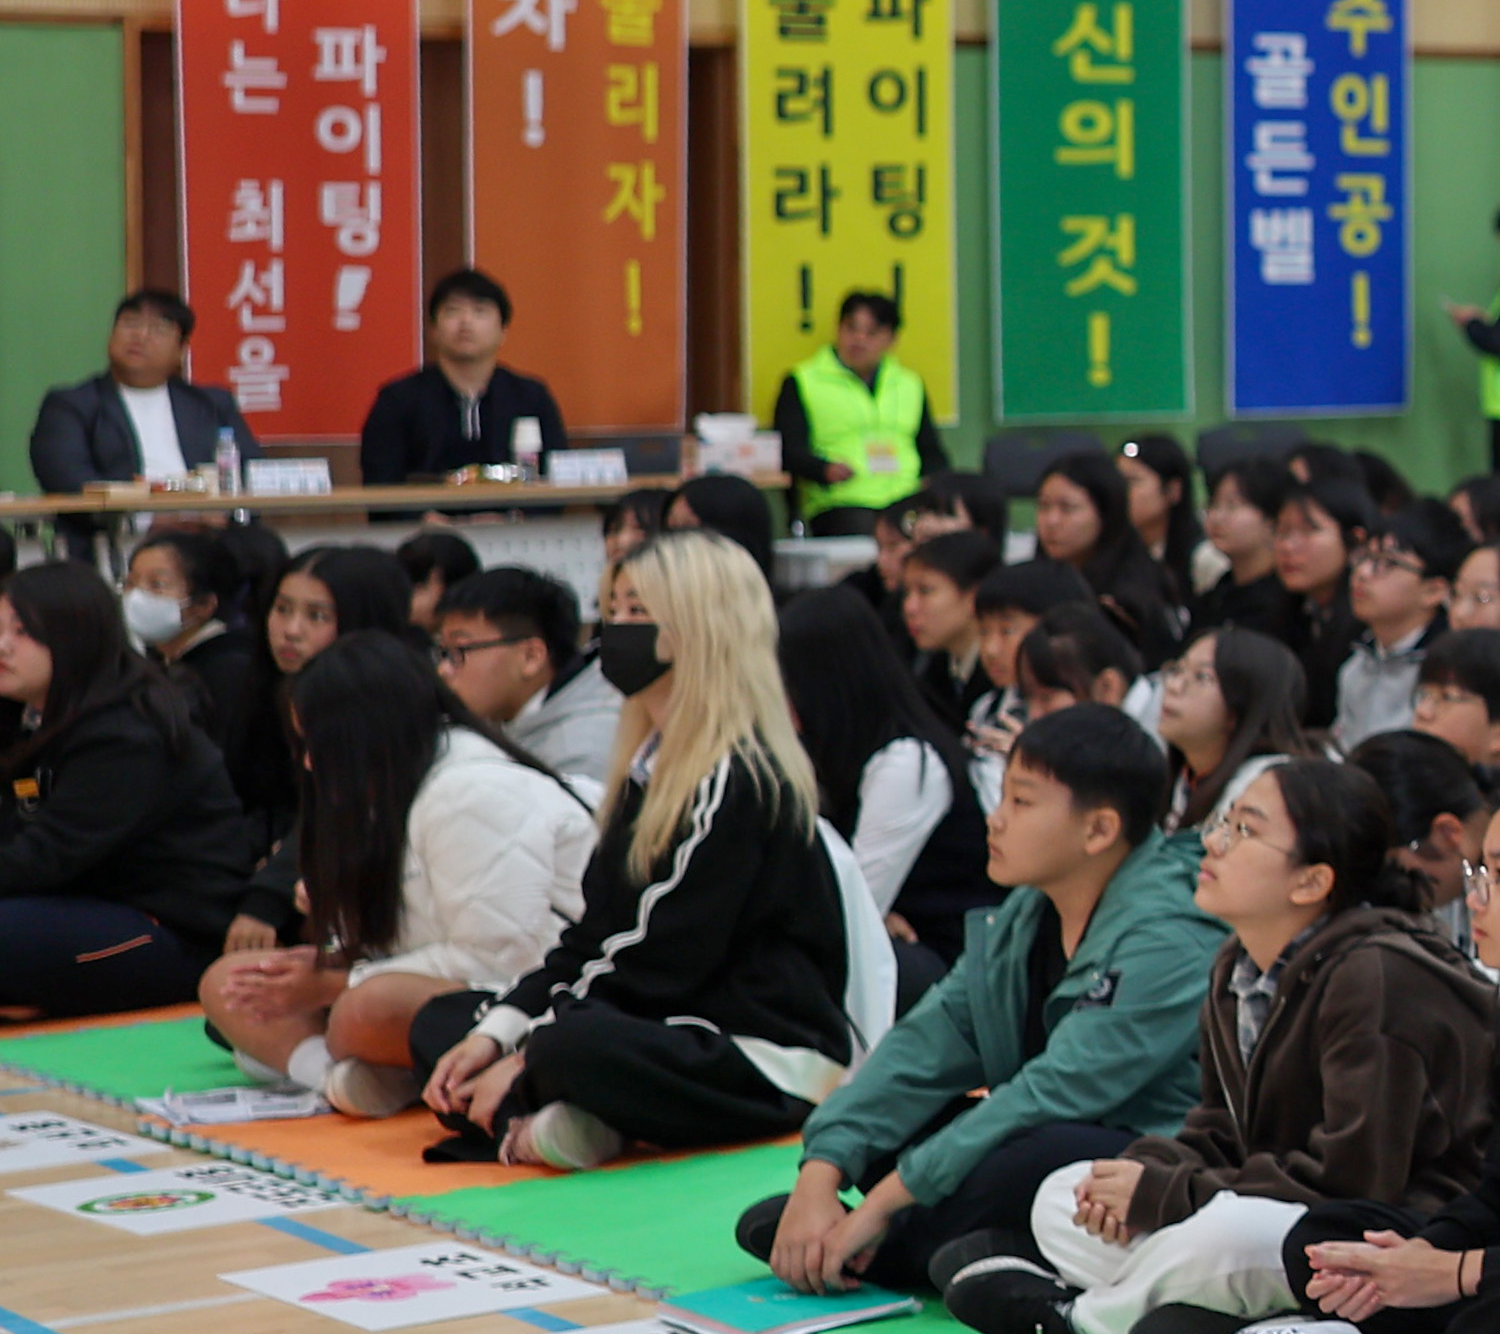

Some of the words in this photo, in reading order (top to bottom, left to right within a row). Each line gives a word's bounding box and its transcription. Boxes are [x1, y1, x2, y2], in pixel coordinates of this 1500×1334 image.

[312, 24, 385, 330] 파이팅!
[1246, 30, 1316, 287] 골든벨
[226, 178, 290, 413] 최선을
[1056, 212, 1138, 388] 것!
